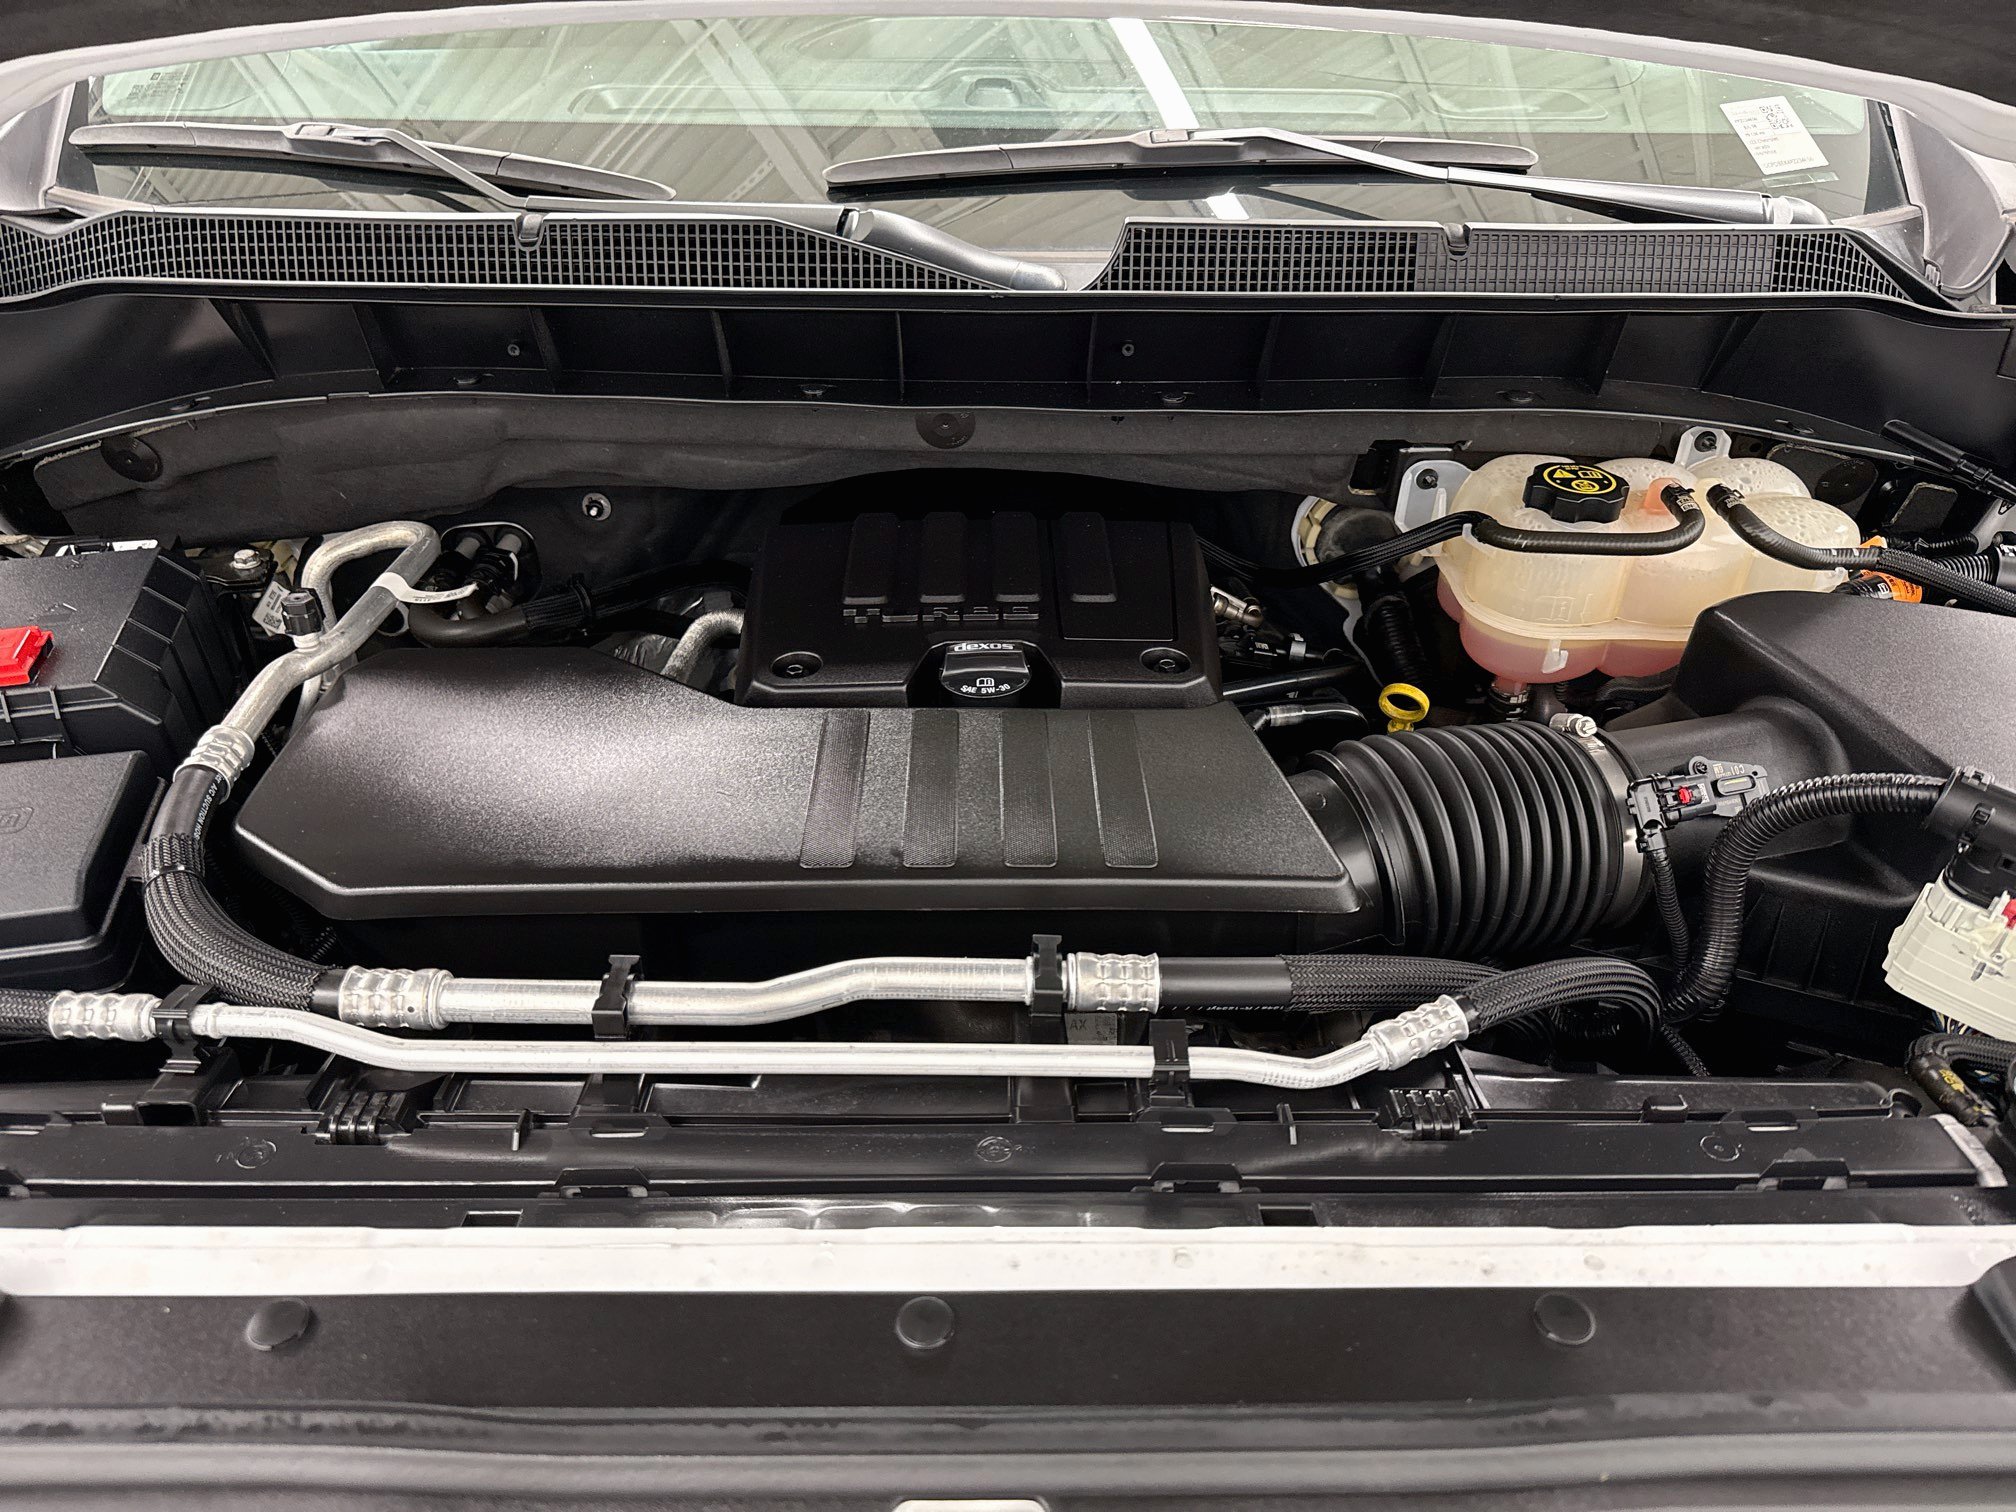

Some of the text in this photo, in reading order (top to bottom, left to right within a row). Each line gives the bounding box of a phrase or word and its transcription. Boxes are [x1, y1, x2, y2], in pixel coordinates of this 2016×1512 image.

[954, 642, 1014, 652] dexos
[960, 683, 1011, 694] SAE 5W-30
[197, 794, 213, 826] SUCTION
